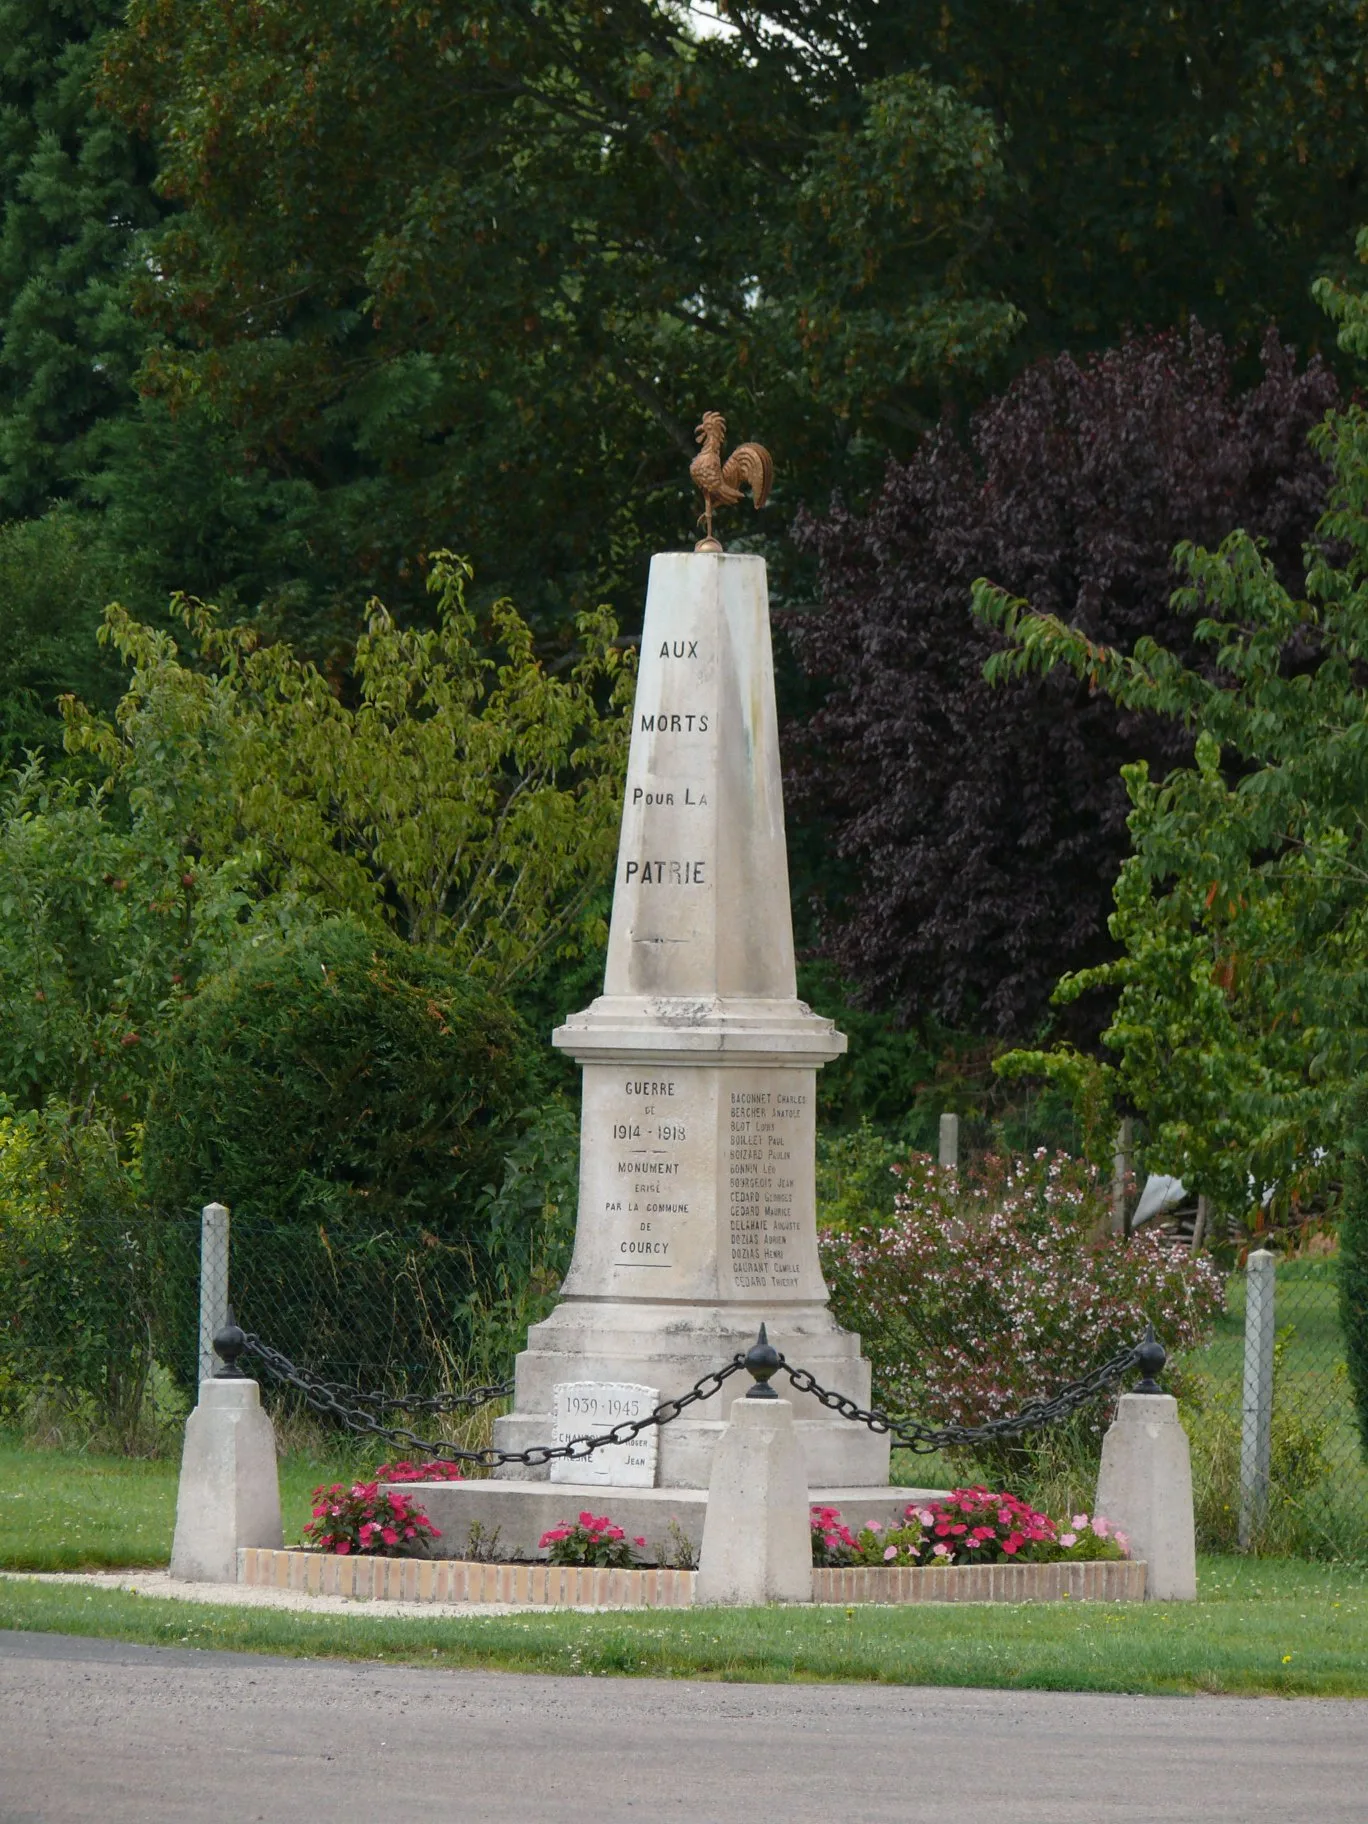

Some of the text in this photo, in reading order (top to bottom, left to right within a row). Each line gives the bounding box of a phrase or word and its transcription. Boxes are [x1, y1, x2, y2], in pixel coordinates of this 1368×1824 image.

[659, 640, 699, 659] AUX
[641, 714, 709, 732] MORTS
[626, 861, 706, 885] PATRIE
[625, 1082, 676, 1096] GUERRE
[645, 1106, 656, 1116] DE
[613, 1124, 641, 1140] 1914
[658, 1125, 686, 1141] 1918
[618, 1162, 680, 1175] MONUMENT
[605, 1202, 690, 1213] PAR LA COMMUNE
[640, 1222, 652, 1232] DE
[620, 1241, 670, 1255] COURCY
[567, 1397, 597, 1417] 1939
[609, 1400, 640, 1418] 1945
[624, 1455, 646, 1466] JEAN
